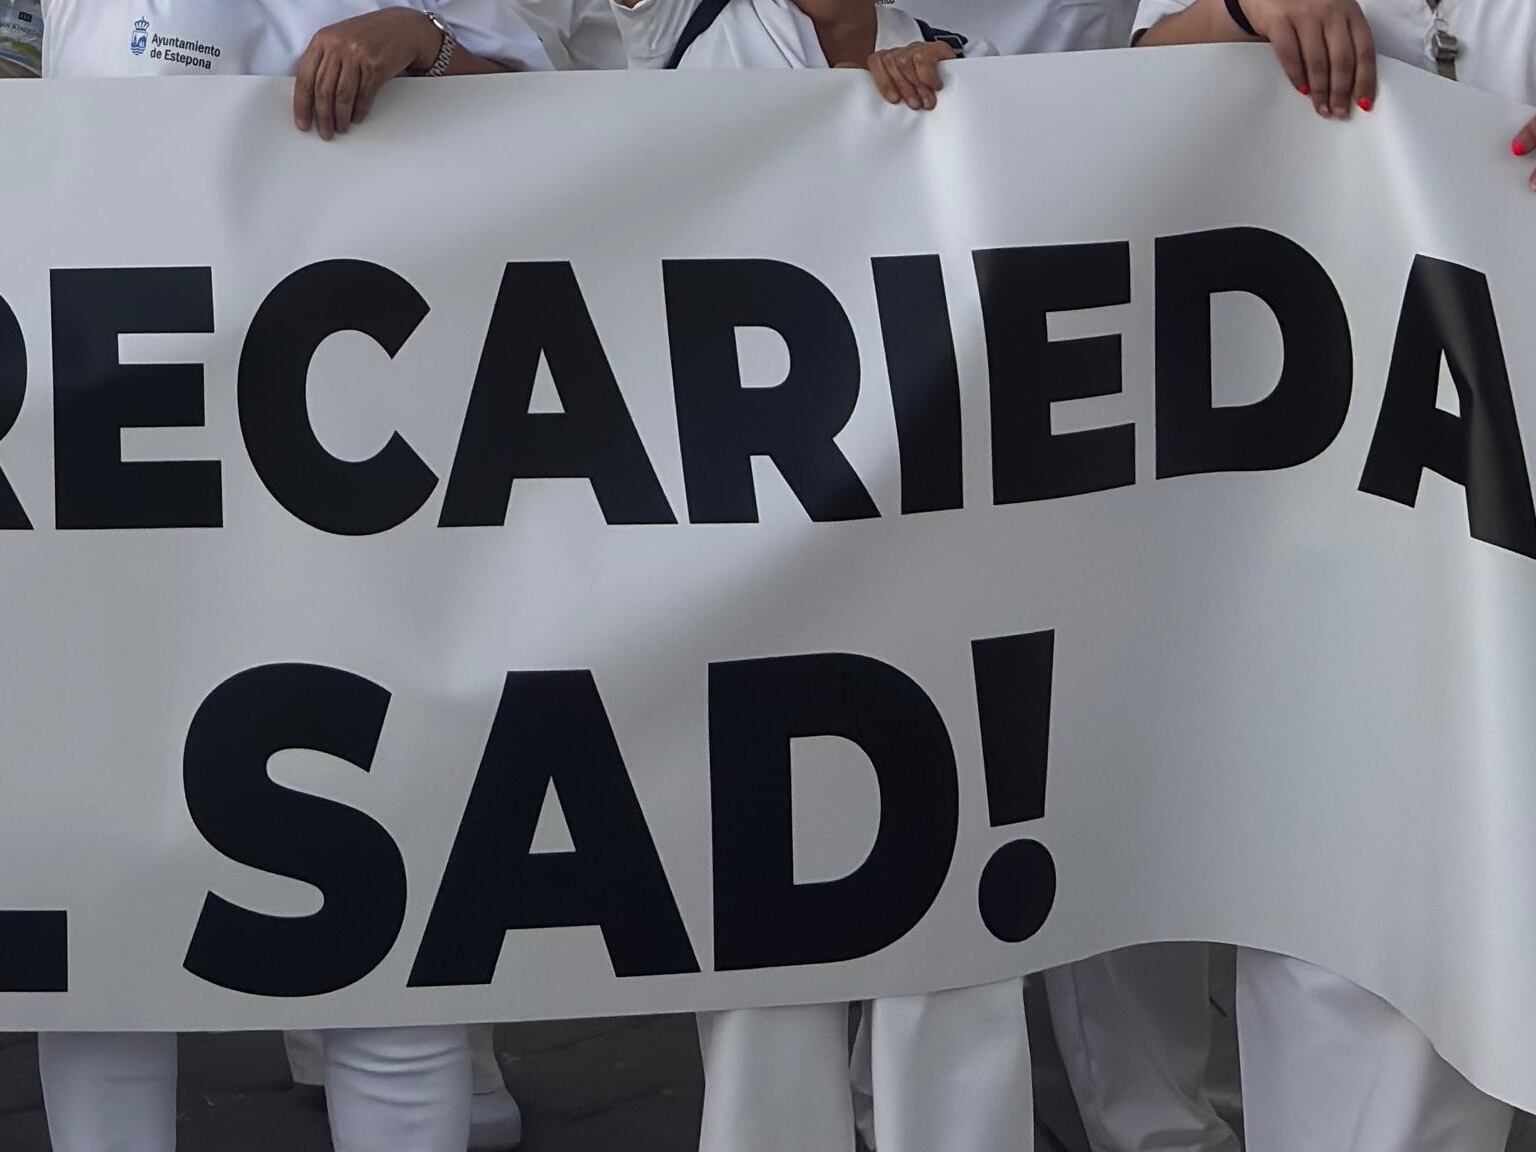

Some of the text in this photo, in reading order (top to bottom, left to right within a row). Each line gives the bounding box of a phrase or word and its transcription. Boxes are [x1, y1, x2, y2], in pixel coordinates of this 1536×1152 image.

[151, 33, 221, 57] Ayuntamiento
[150, 48, 212, 70] de Estepona
[182, 628, 1057, 998] SAD!
